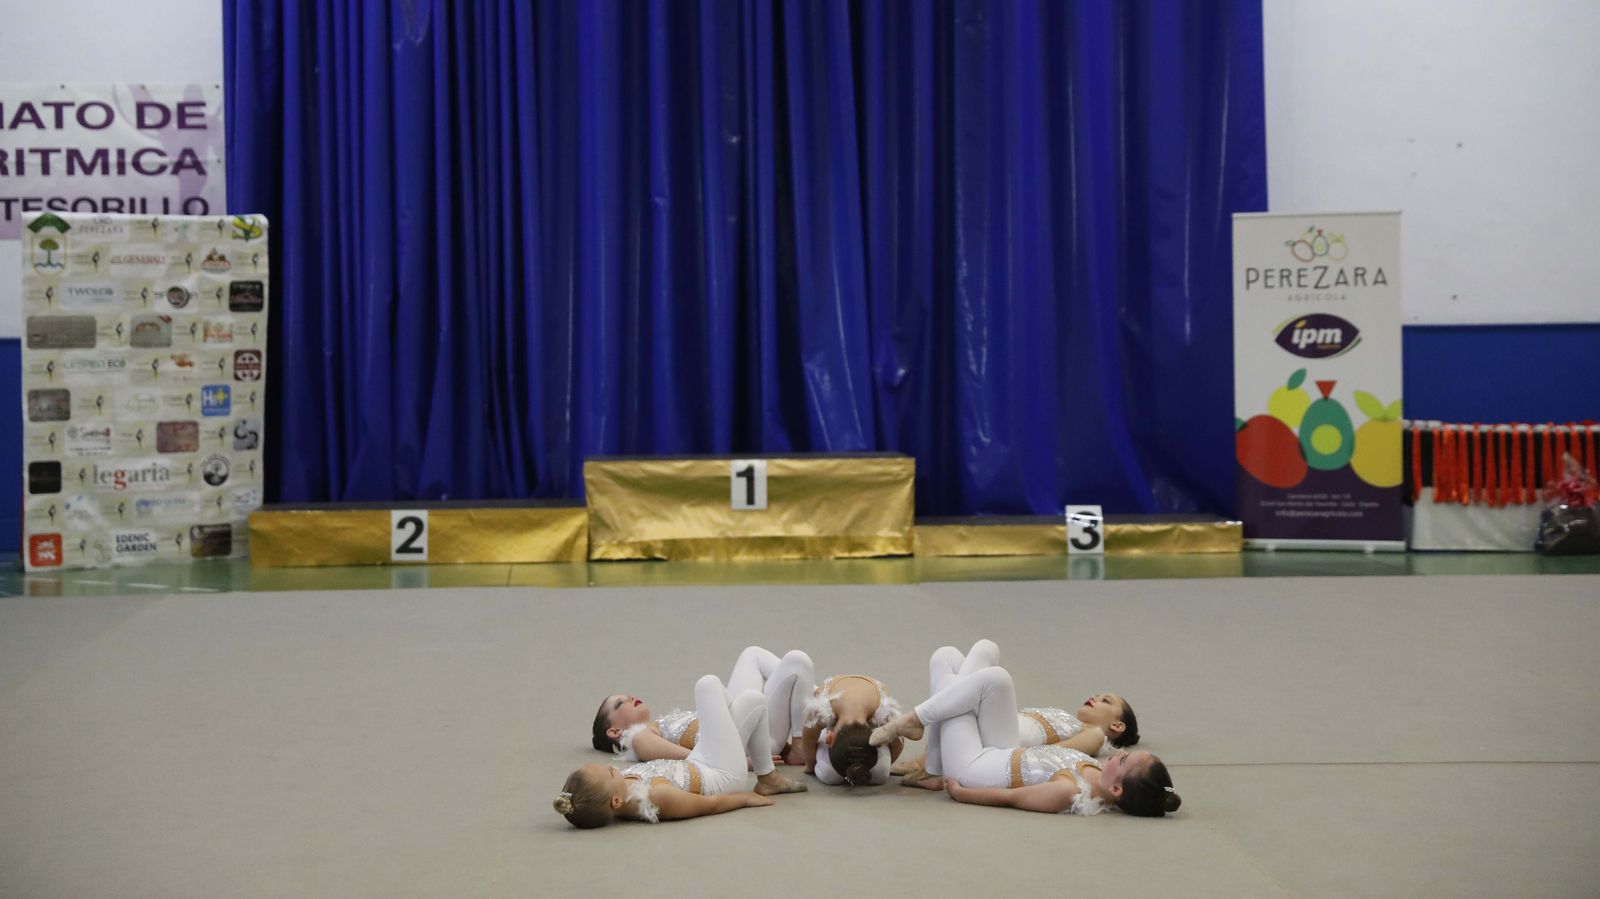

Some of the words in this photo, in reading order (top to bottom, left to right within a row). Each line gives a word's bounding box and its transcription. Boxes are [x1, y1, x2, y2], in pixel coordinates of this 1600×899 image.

[0, 101, 115, 130] ATO
[136, 101, 208, 131] DE
[1245, 266, 1388, 291] PEREZARA
[1291, 319, 1343, 349] ipm
[93, 463, 170, 490] legaria
[736, 464, 755, 506] 1
[115, 533, 150, 543] EDENIC
[396, 516, 424, 554] 2
[1070, 511, 1100, 550] 3
[116, 542, 157, 553] GARDEN
